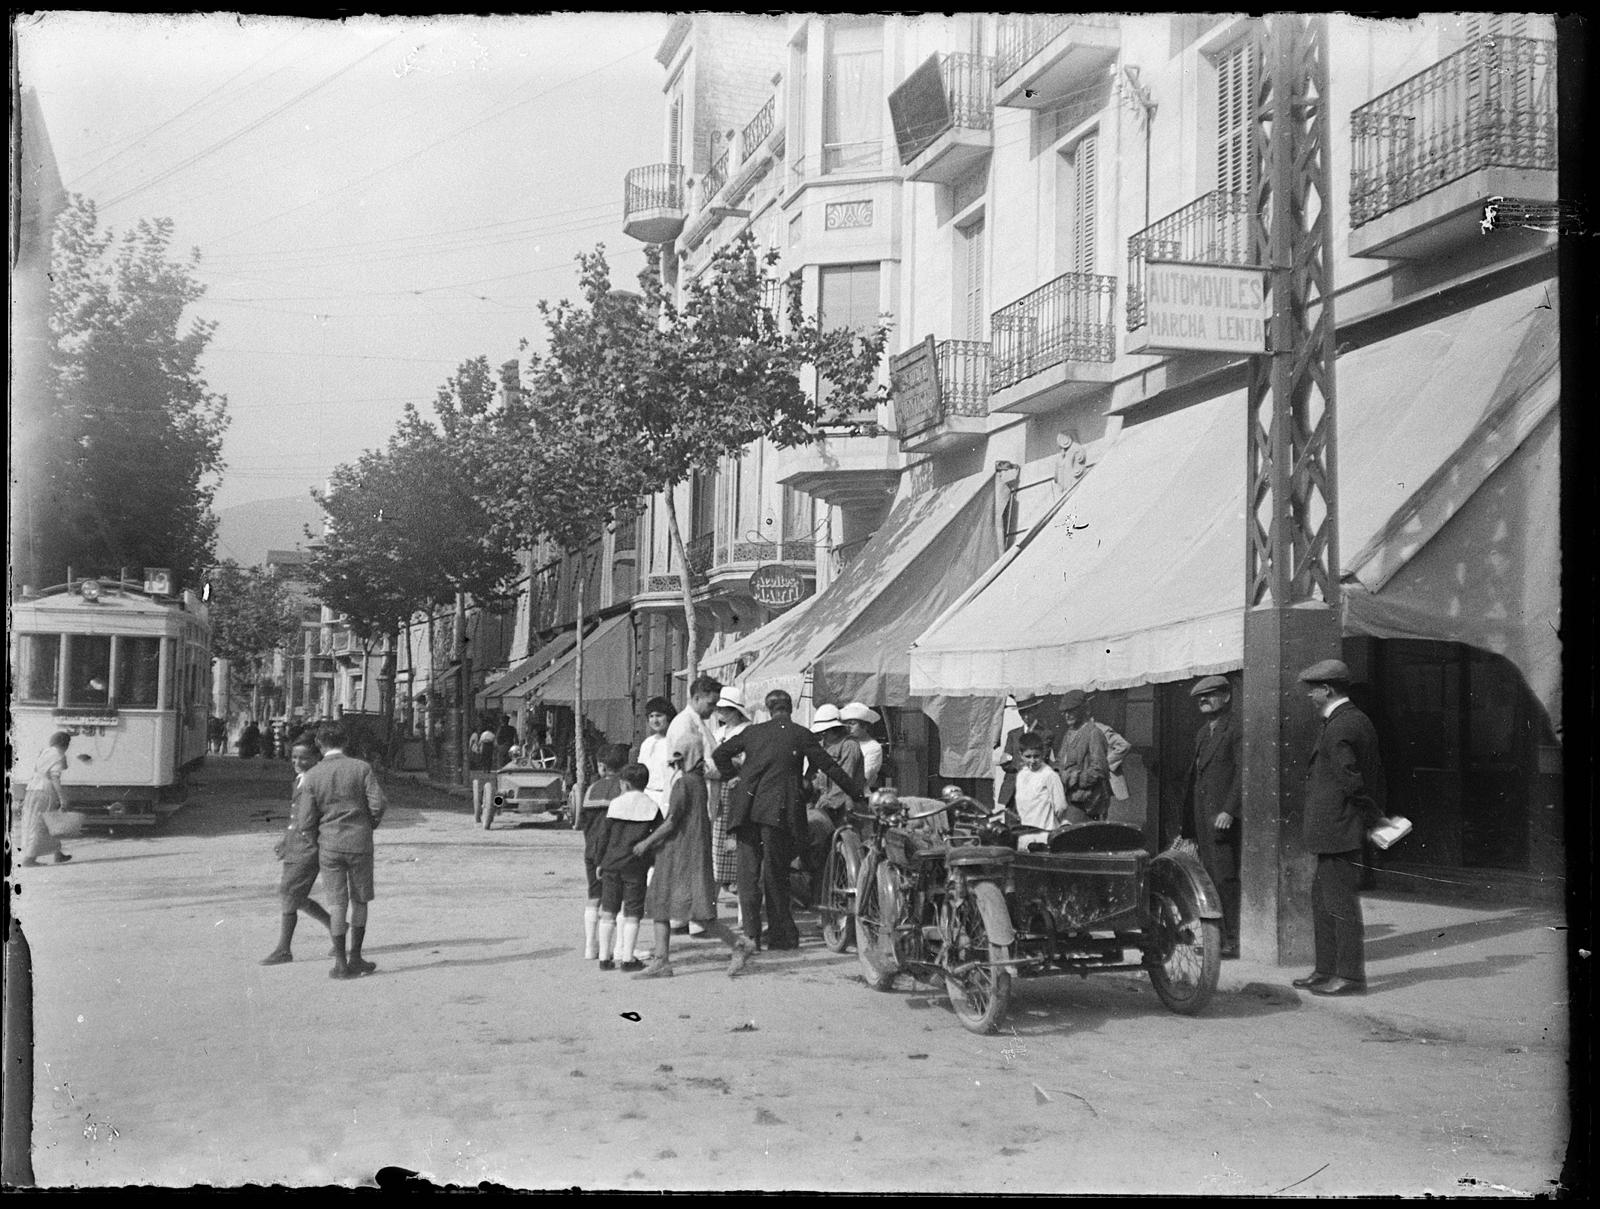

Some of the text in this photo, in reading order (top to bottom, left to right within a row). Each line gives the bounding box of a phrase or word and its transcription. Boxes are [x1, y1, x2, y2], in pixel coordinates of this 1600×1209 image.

[1149, 270, 1261, 310] AUTOMOVILES
[1150, 311, 1263, 342] MARCHA LENTA
